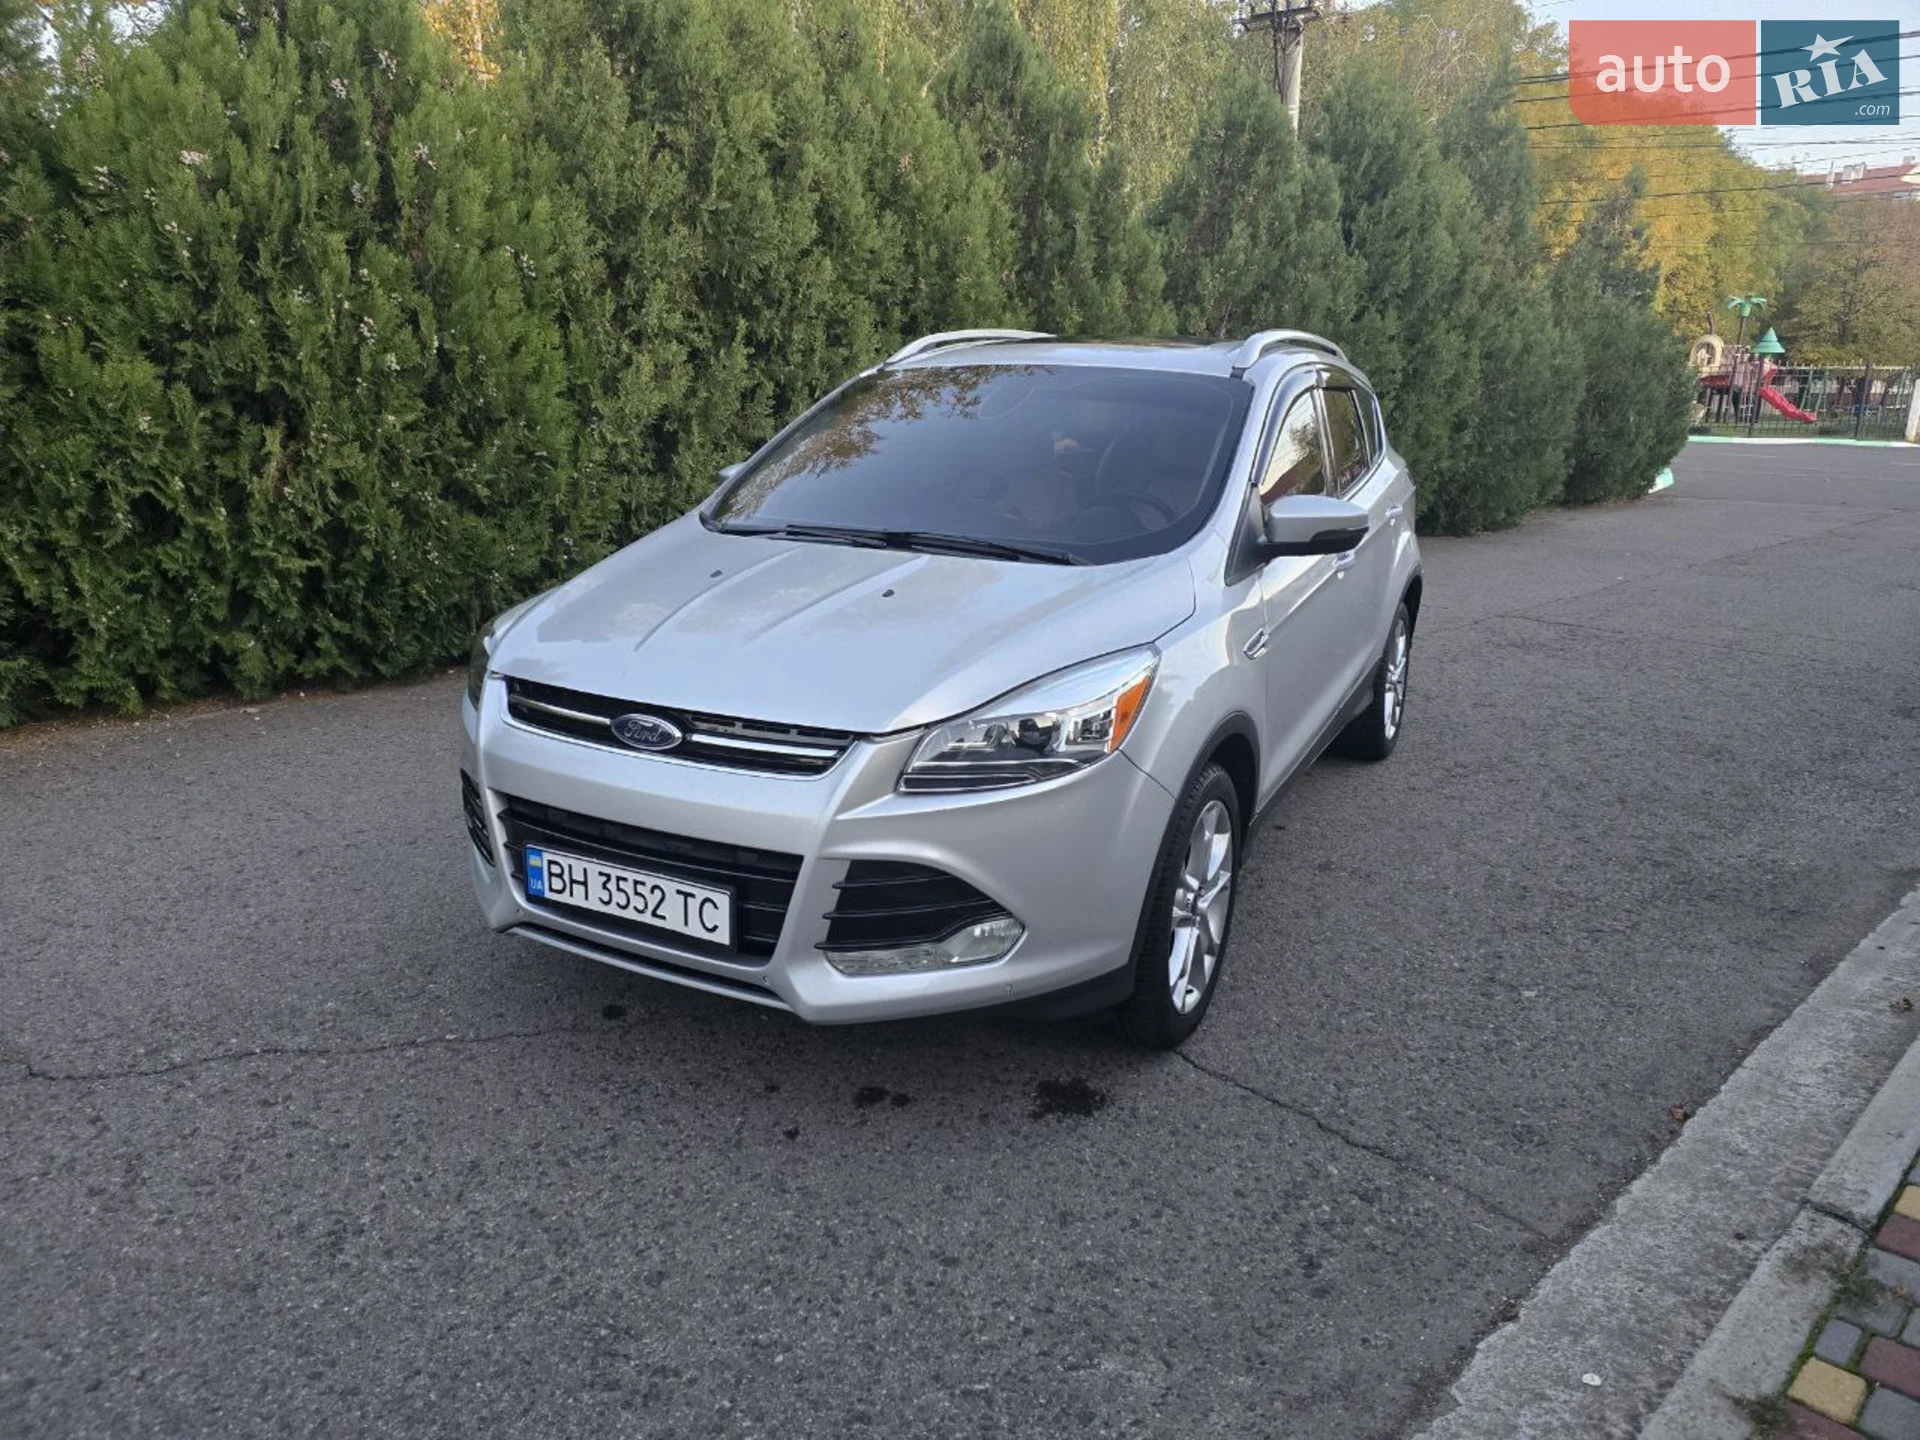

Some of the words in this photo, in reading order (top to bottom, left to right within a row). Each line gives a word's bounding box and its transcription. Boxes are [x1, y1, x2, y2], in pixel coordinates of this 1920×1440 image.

[623, 719, 661, 742] Ford
[530, 877, 544, 891] UA
[547, 859, 589, 901] BH
[598, 870, 667, 921] 3552
[676, 889, 720, 934] TC
